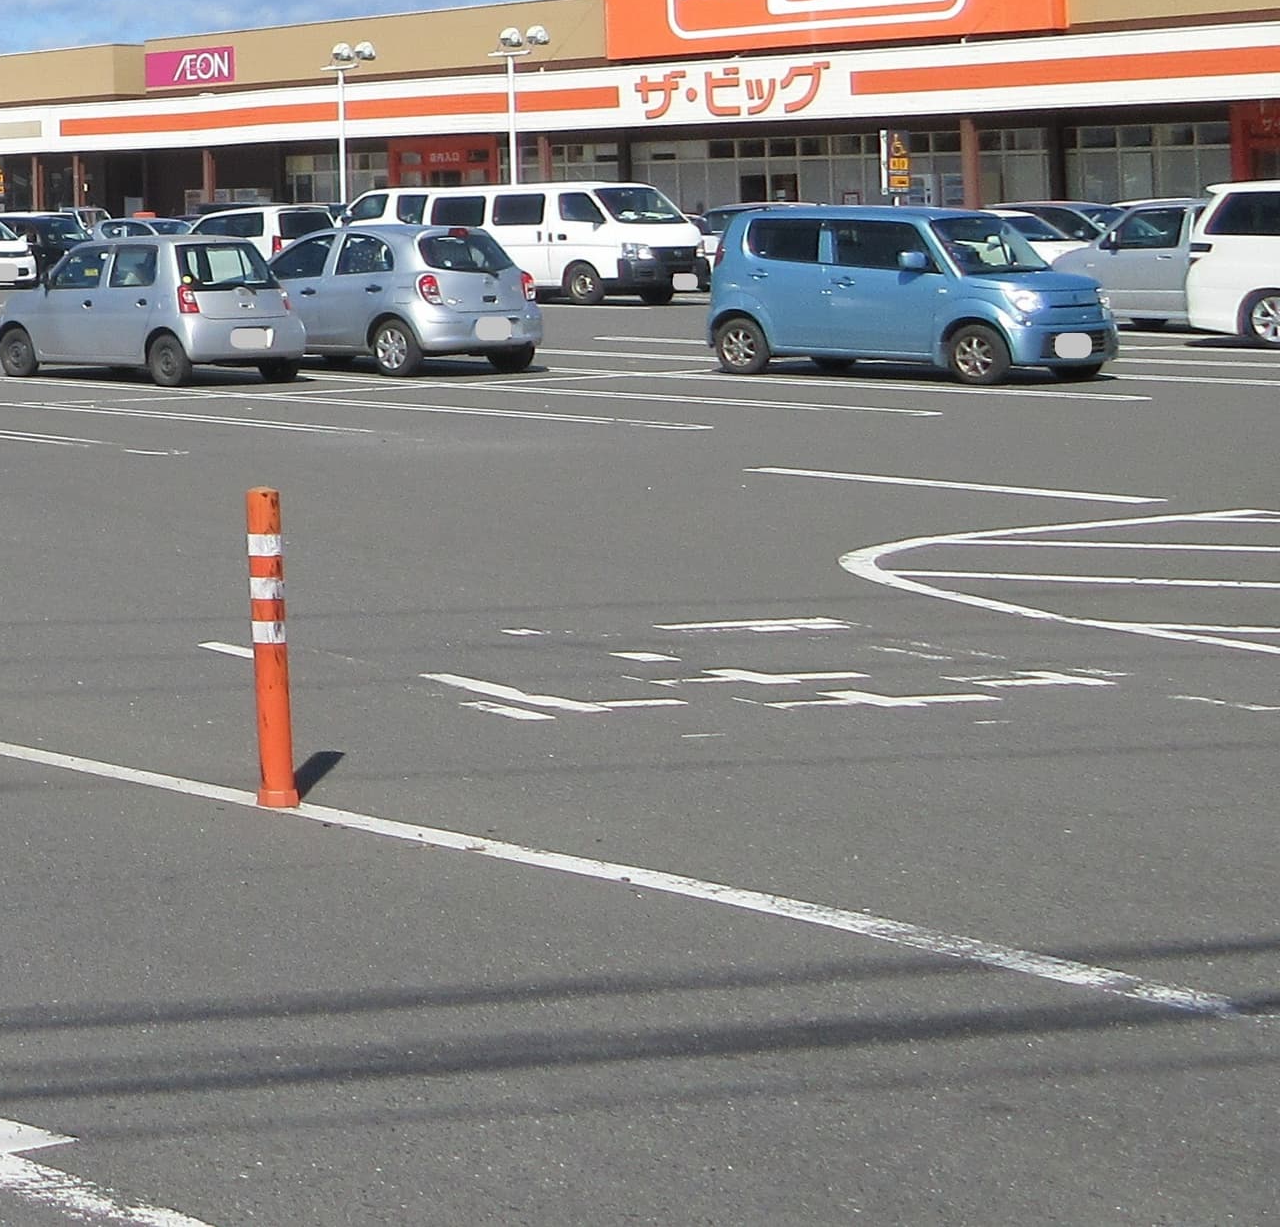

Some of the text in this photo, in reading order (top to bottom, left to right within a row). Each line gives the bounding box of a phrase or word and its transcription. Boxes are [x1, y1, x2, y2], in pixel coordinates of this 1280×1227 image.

[634, 60, 830, 120] ザ・ビッグ
